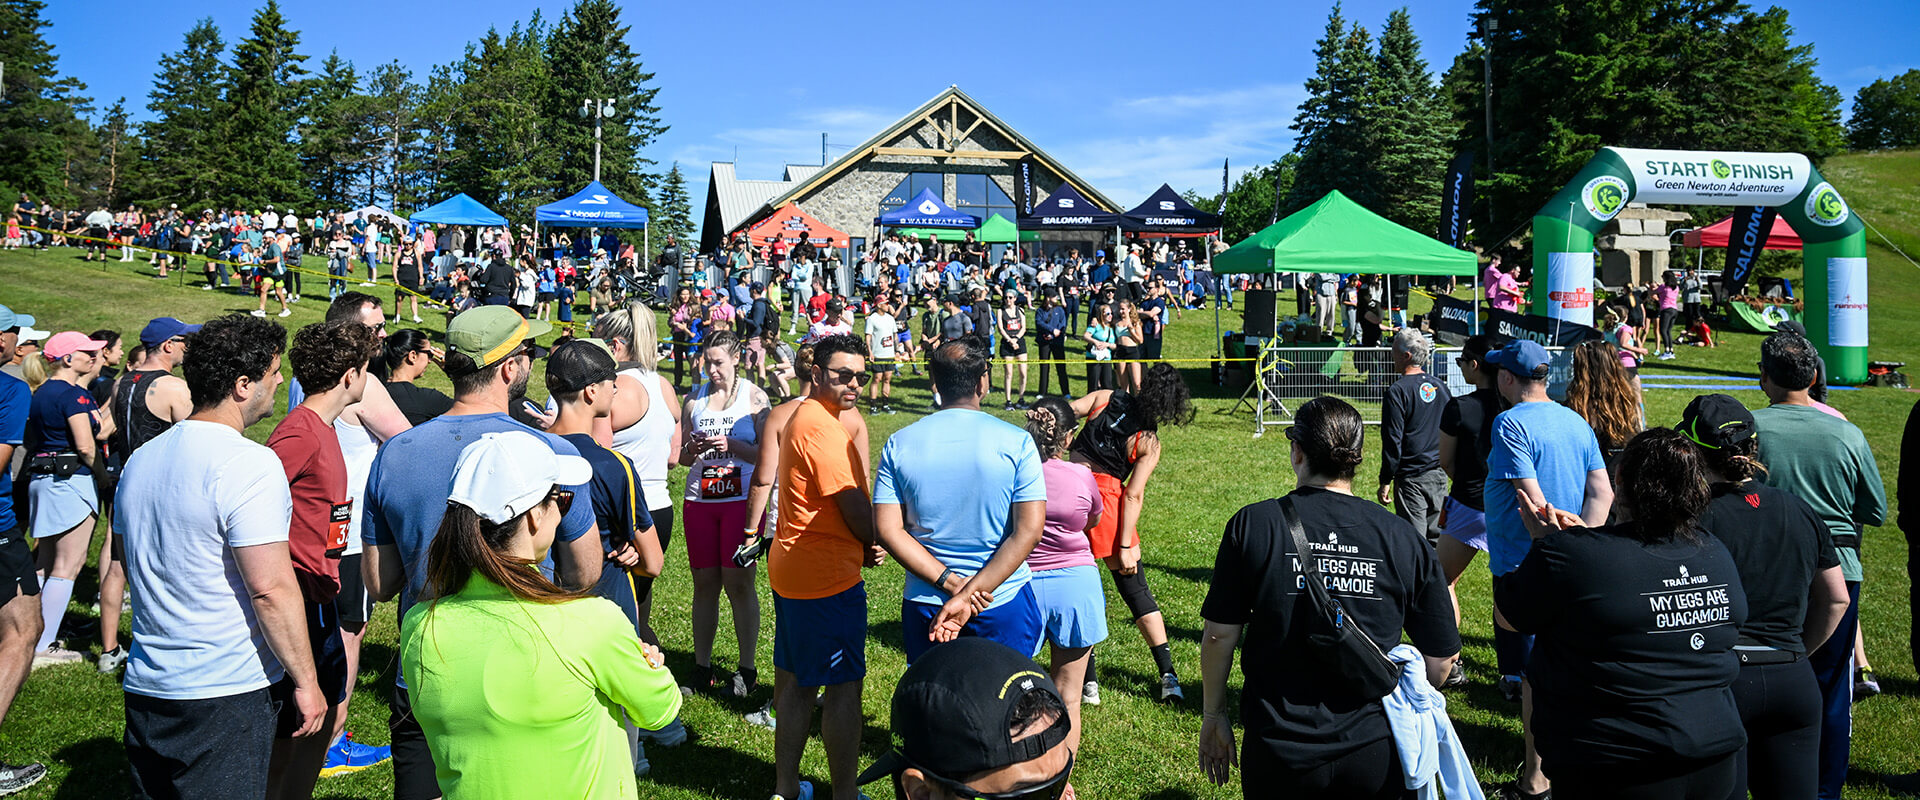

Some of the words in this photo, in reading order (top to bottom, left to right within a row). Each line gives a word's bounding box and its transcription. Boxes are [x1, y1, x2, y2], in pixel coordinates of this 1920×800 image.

[1646, 160, 1708, 177] START
[1731, 164, 1794, 180] FINISH
[1655, 179, 1685, 190] Green
[1687, 181, 1727, 192] Newton
[1728, 182, 1785, 193] Adventures
[1449, 172, 1463, 248] LOMON
[1042, 216, 1093, 225] SALOMON
[1145, 217, 1196, 225] SALOMON
[1733, 205, 1765, 281] SALOM
[707, 480, 736, 494] 404
[1309, 542, 1337, 552] TRAIL
[1338, 544, 1359, 554] HUB
[1318, 558, 1347, 575] LEGS
[1350, 561, 1377, 578] ARE
[1296, 574, 1375, 594] GCAMOLE
[1662, 577, 1690, 587] TRAIL
[1690, 575, 1709, 585] HUB
[1649, 595, 1673, 612] MY
[1675, 592, 1705, 610] LEGS
[1706, 588, 1730, 606] ARE
[1656, 606, 1730, 628] GUACAMOLE
